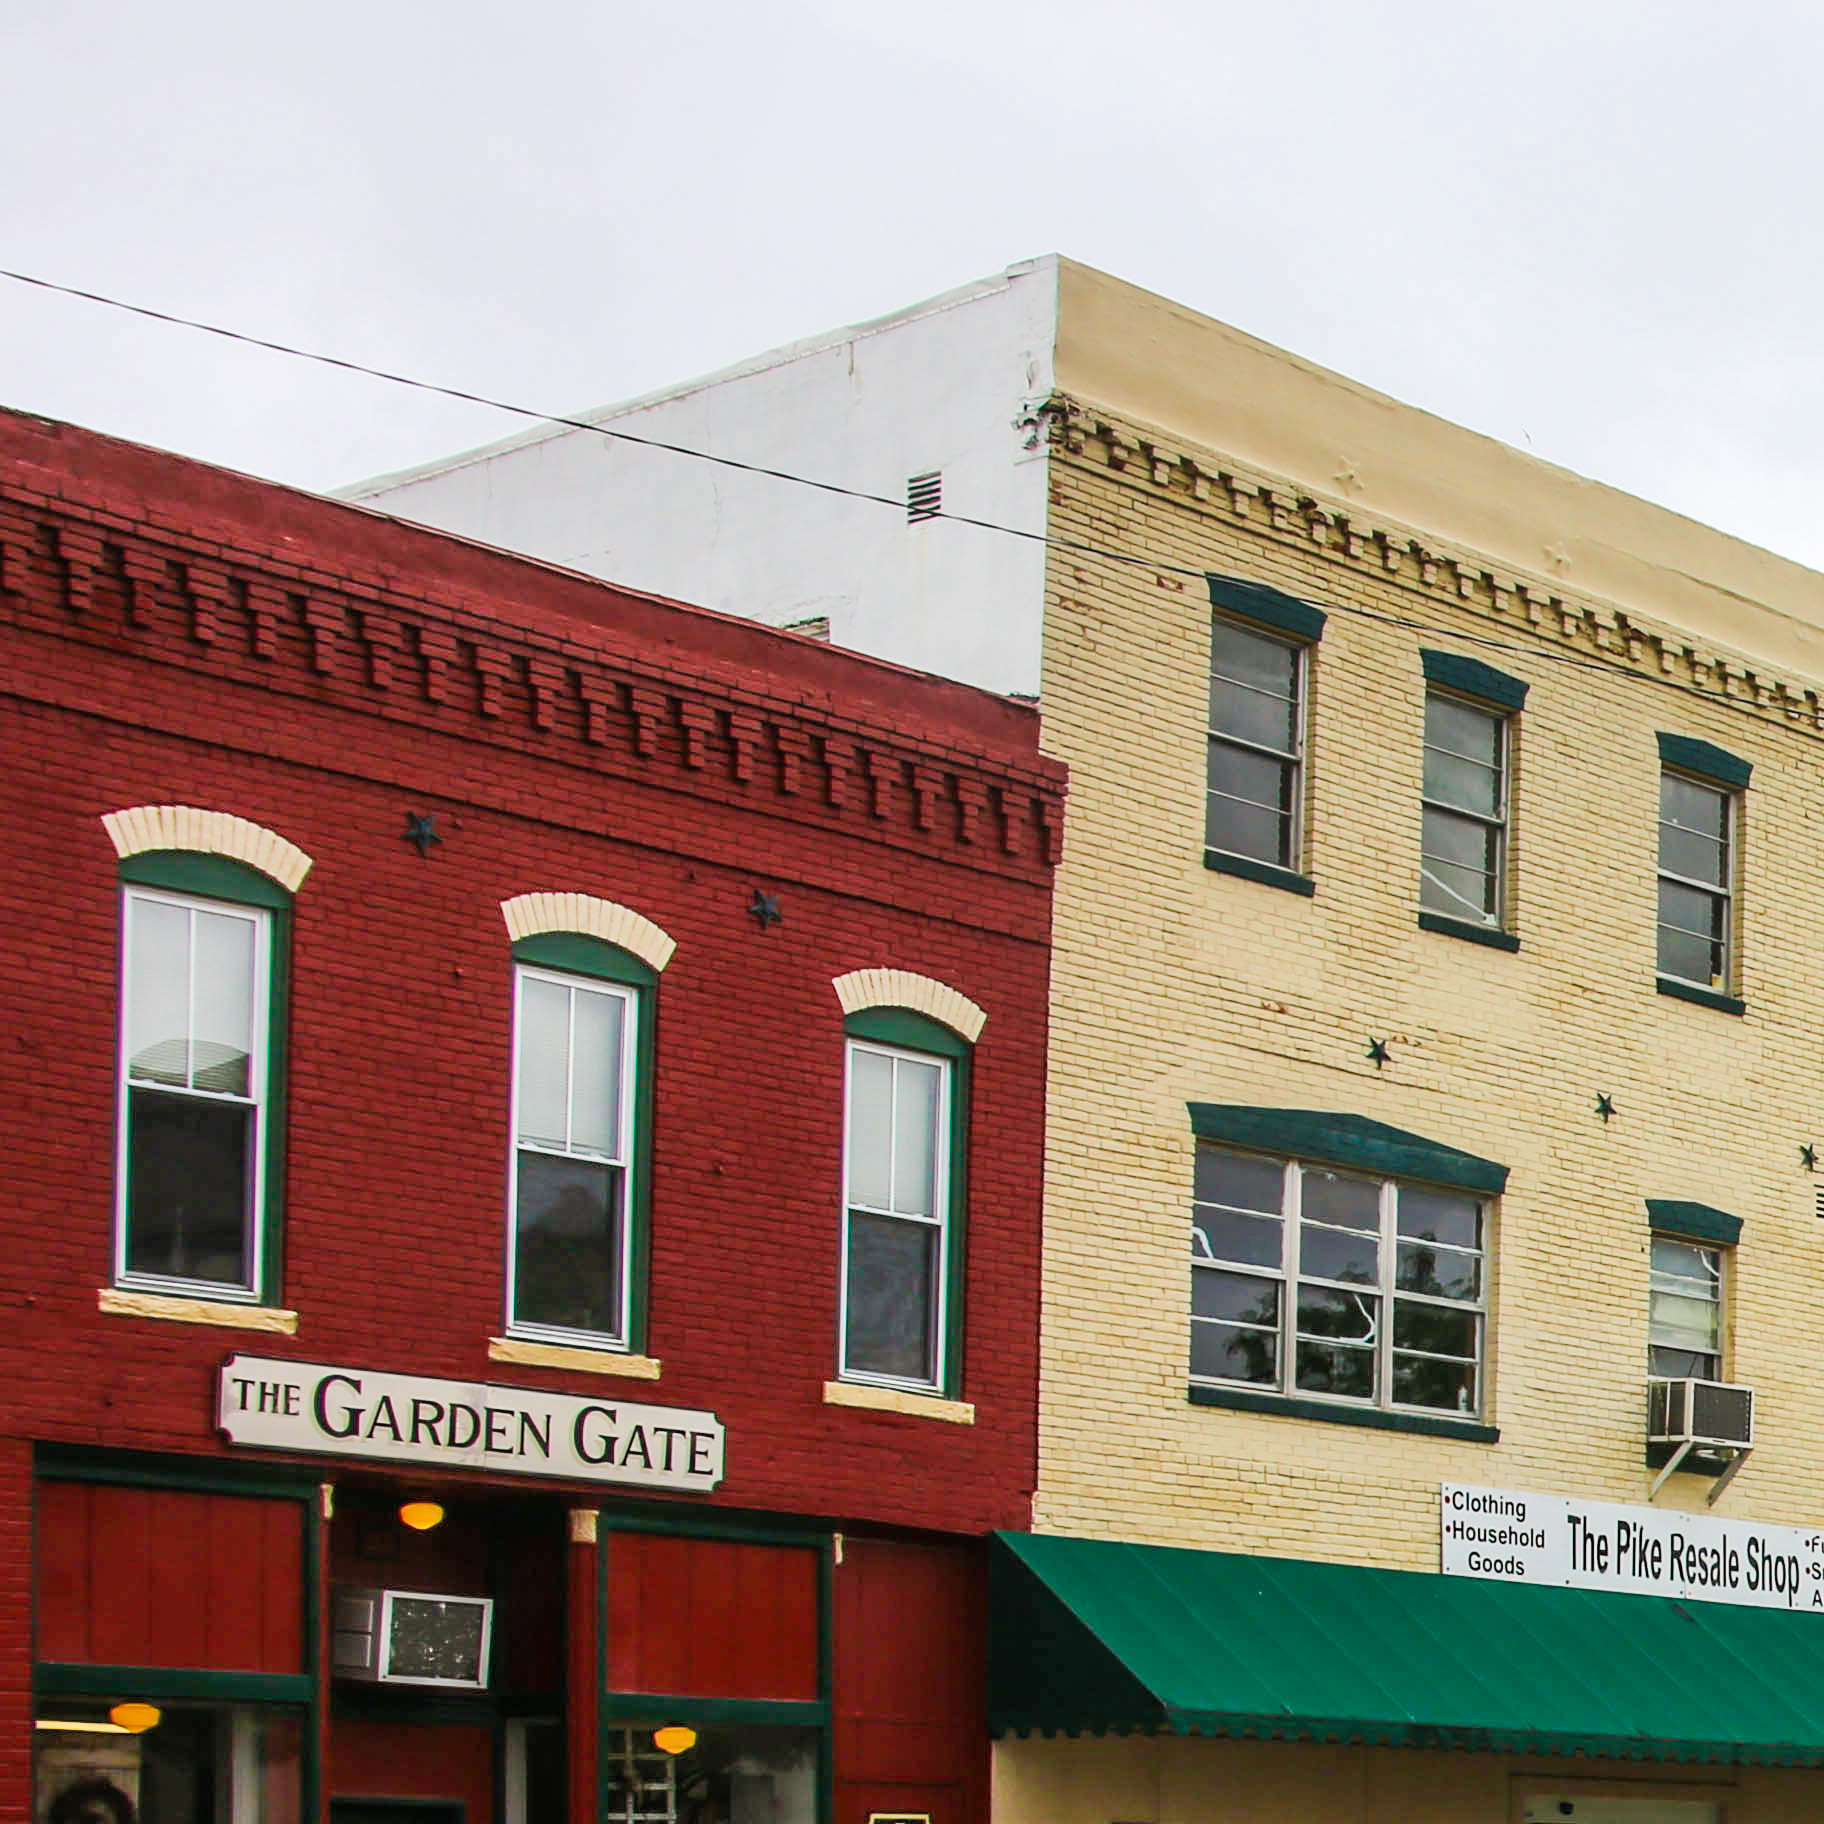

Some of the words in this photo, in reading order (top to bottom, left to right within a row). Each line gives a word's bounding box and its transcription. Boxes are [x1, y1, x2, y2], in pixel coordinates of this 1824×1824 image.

[233, 1377, 300, 1416] THE
[1452, 1491, 1526, 1522] Clothing
[1453, 1520, 1545, 1548] Household
[1468, 1552, 1525, 1576] Goods
[1567, 1514, 1609, 1574] The
[1617, 1519, 1662, 1580] Pike
[1670, 1533, 1739, 1589] Resale
[1746, 1536, 1800, 1607] Shop
